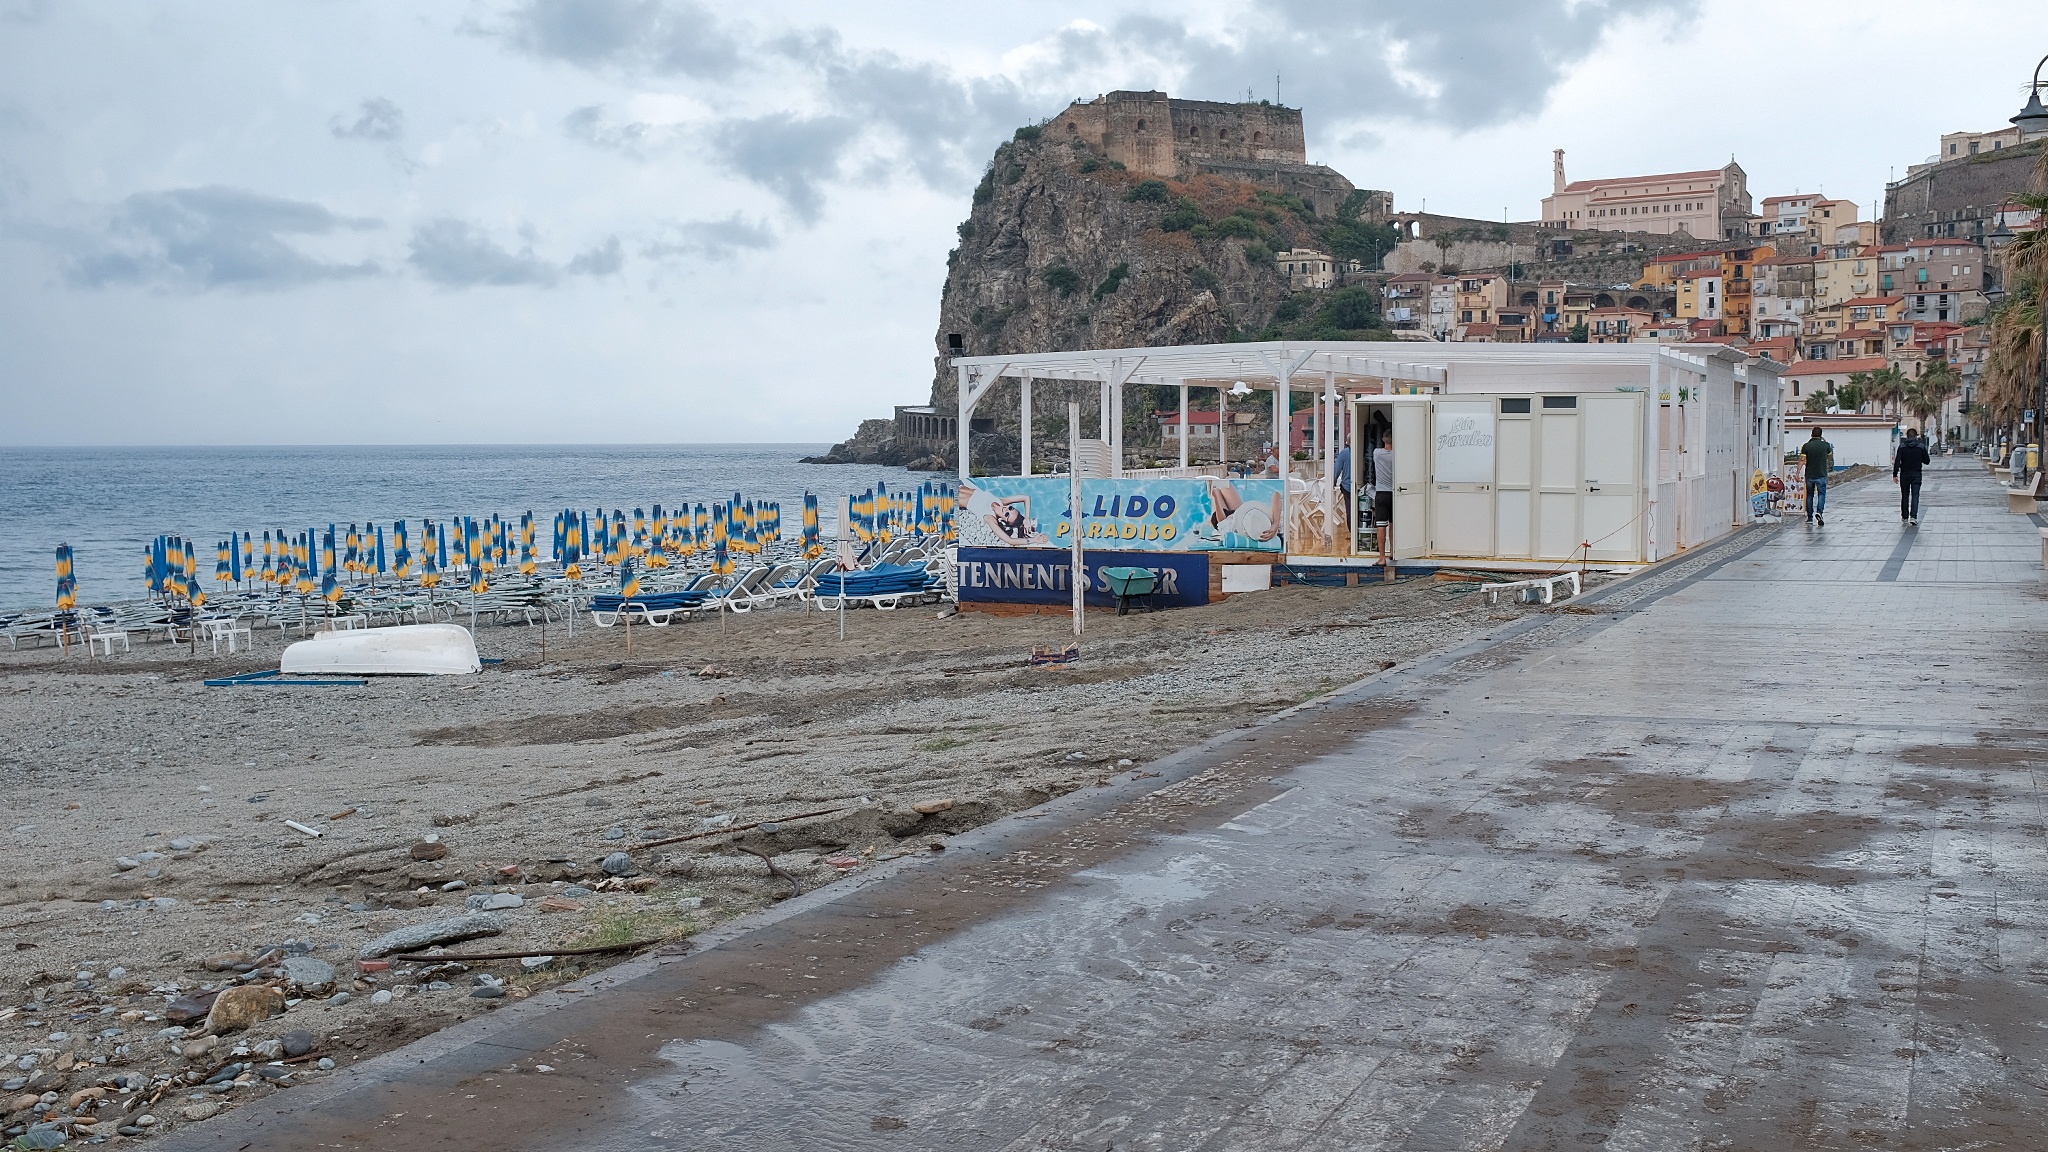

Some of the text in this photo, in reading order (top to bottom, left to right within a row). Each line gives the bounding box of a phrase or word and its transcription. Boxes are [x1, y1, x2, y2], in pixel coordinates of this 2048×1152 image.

[1092, 494, 1177, 520] LIDO
[957, 561, 1180, 595] TENNENTS SER
